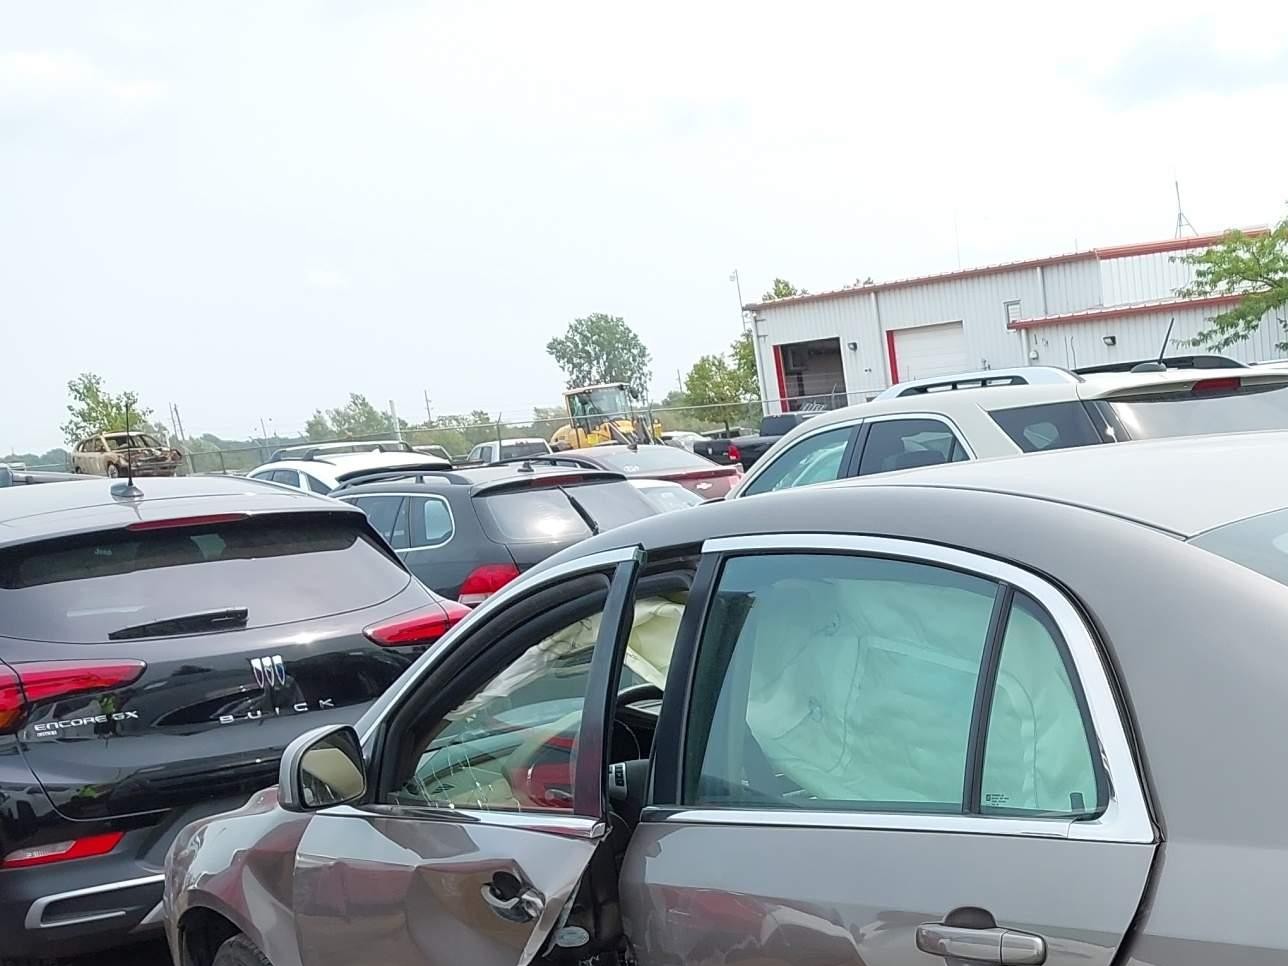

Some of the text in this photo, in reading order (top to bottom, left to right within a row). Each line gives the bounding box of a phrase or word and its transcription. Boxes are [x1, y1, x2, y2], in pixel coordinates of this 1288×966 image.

[34, 710, 139, 732] ENCORE GX
[219, 697, 335, 725] BUICK
